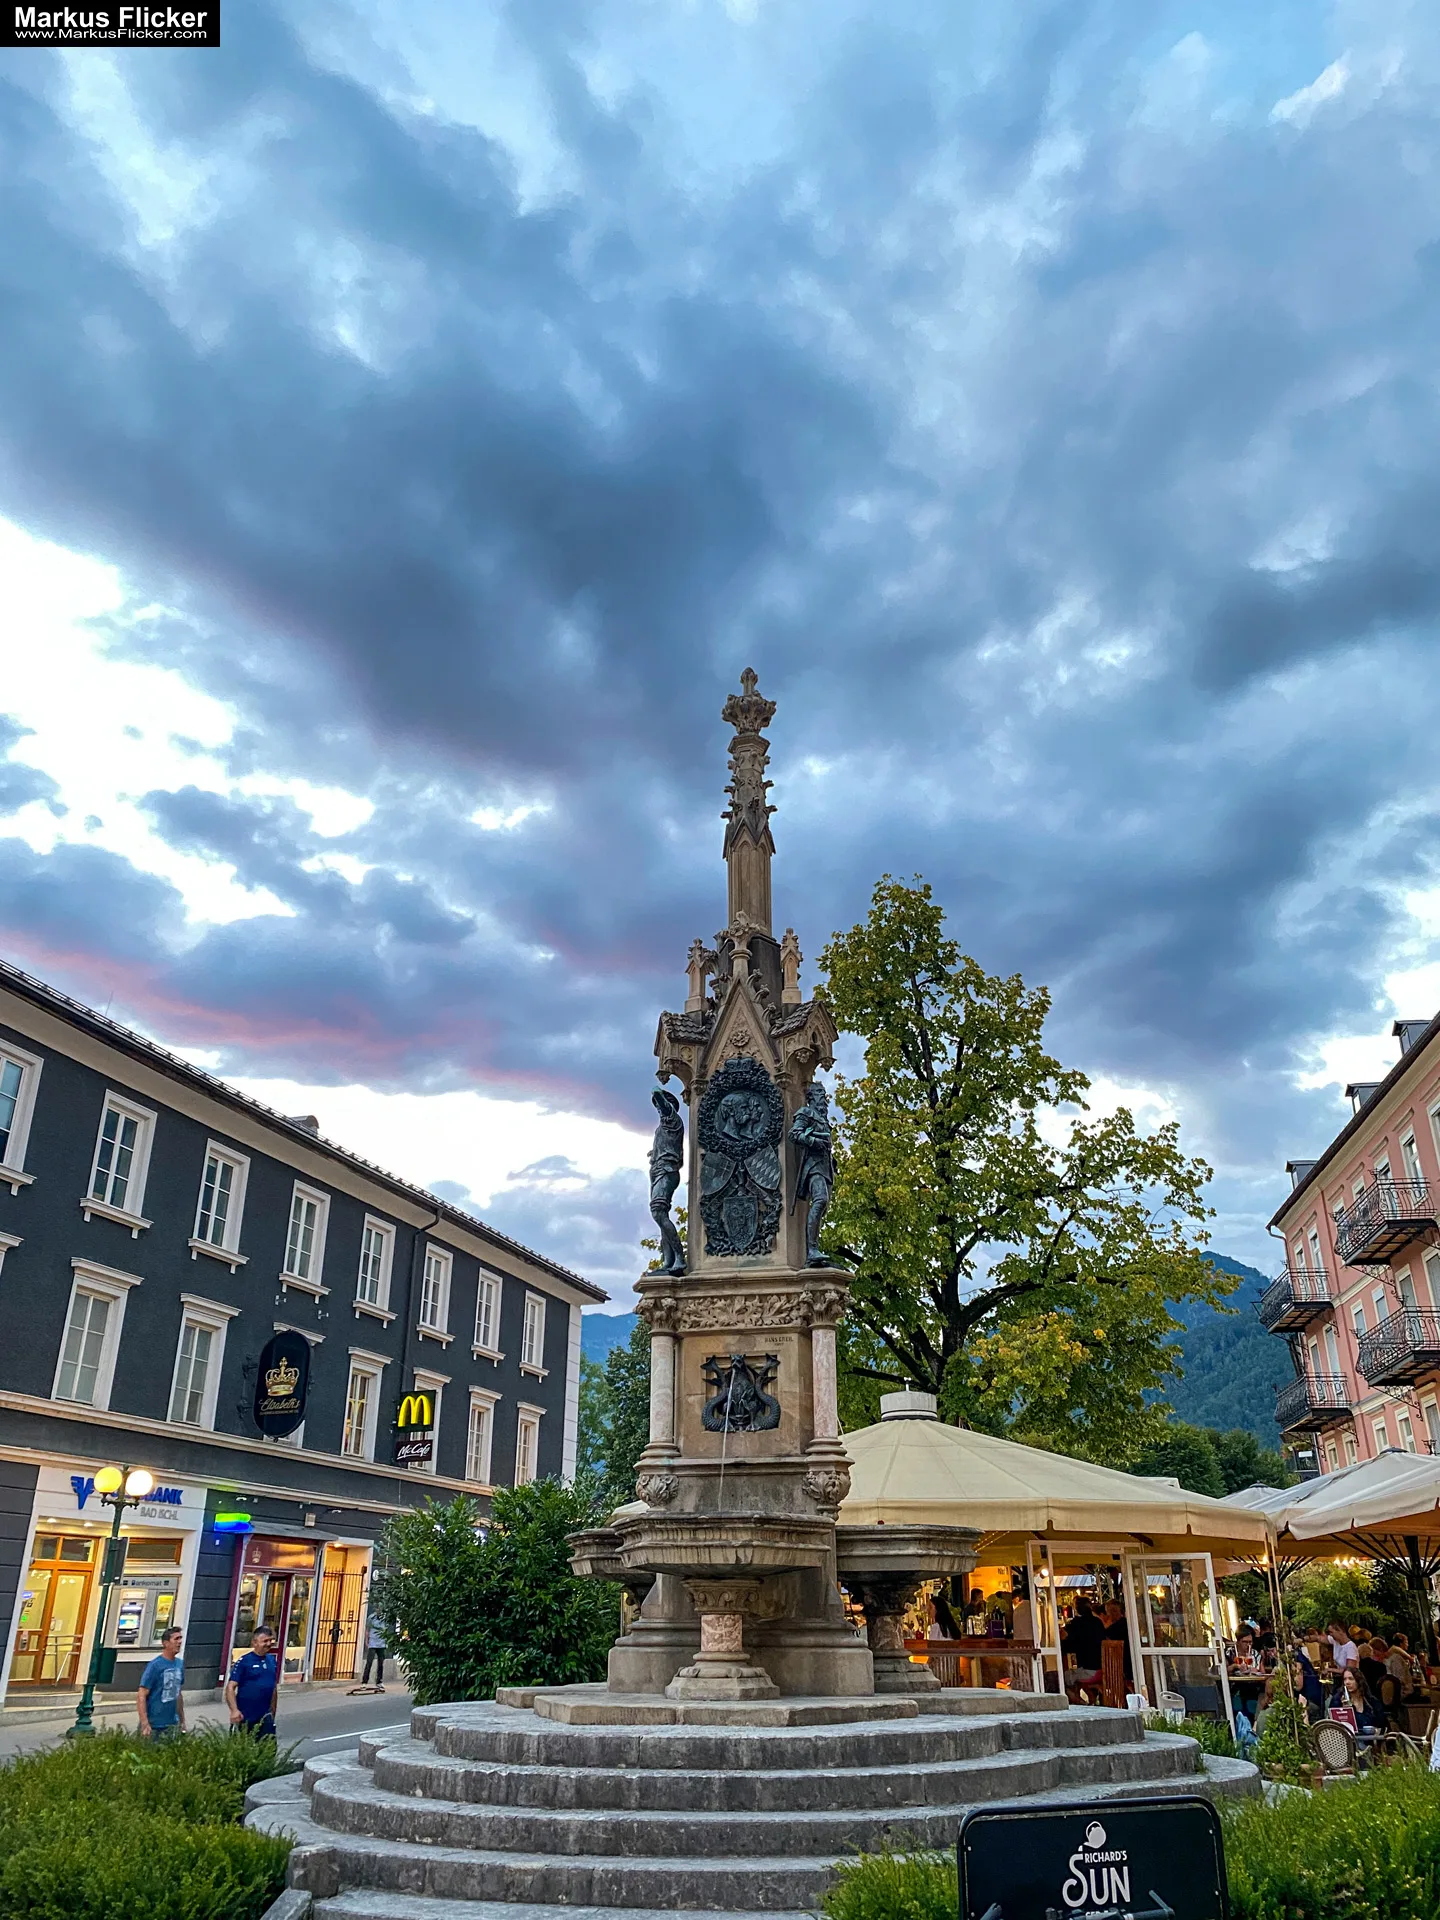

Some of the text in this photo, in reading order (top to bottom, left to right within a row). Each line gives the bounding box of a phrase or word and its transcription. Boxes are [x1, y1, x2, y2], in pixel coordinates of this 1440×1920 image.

[140, 1506, 179, 1521] BAD ISCHL
[1084, 1850, 1128, 1864] RICHARD'S
[1062, 1853, 1131, 1908] SUN
